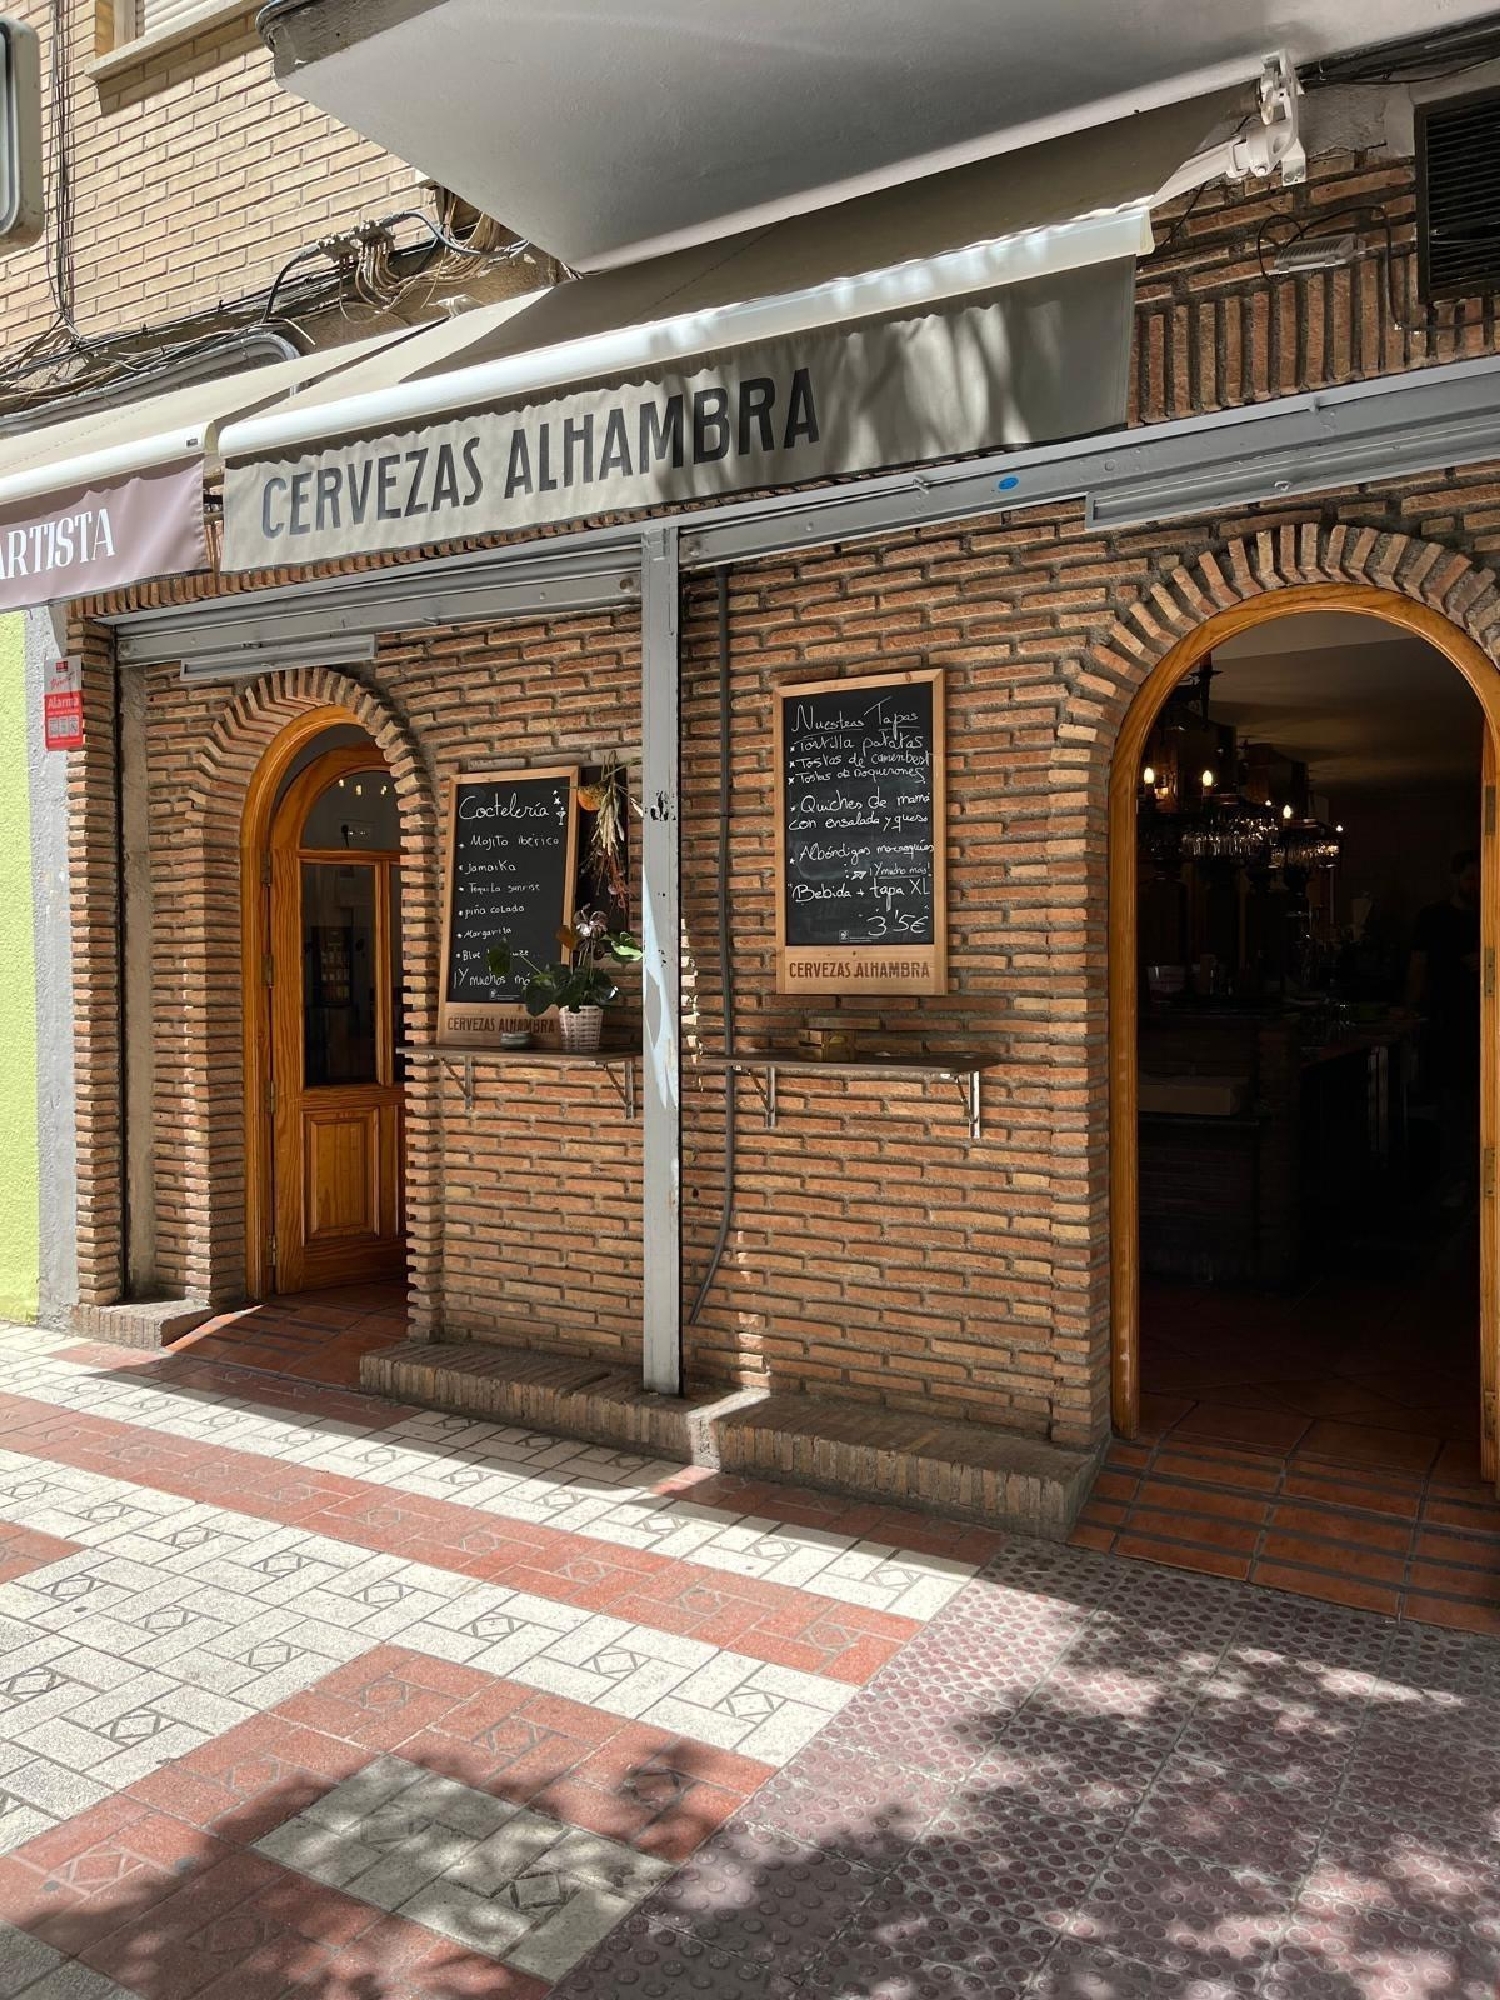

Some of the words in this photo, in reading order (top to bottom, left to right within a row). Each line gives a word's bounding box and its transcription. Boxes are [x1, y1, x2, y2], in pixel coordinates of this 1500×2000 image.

[262, 435, 483, 540] CERVEZAS
[503, 367, 820, 500] ALHAMBRA
[0, 508, 115, 580] RTISTA
[864, 696, 920, 740] Tapas
[863, 733, 924, 757] patatas
[848, 752, 866, 768] de
[459, 792, 549, 820] Coctelería
[800, 789, 863, 813] Quiches
[868, 786, 887, 809] de
[789, 818, 817, 831] con
[825, 811, 880, 829] ensalada
[883, 817, 892, 832] y
[800, 842, 871, 866] Albóndigas
[792, 883, 852, 903] Bebida
[869, 877, 905, 911] tapa
[909, 877, 930, 895] XL
[789, 962, 851, 979] CERVEZAS
[853, 962, 930, 979] ALHAMBRA
[447, 1017, 495, 1033] CERVEZAS
[498, 1017, 556, 1034] ALHAMBRA
